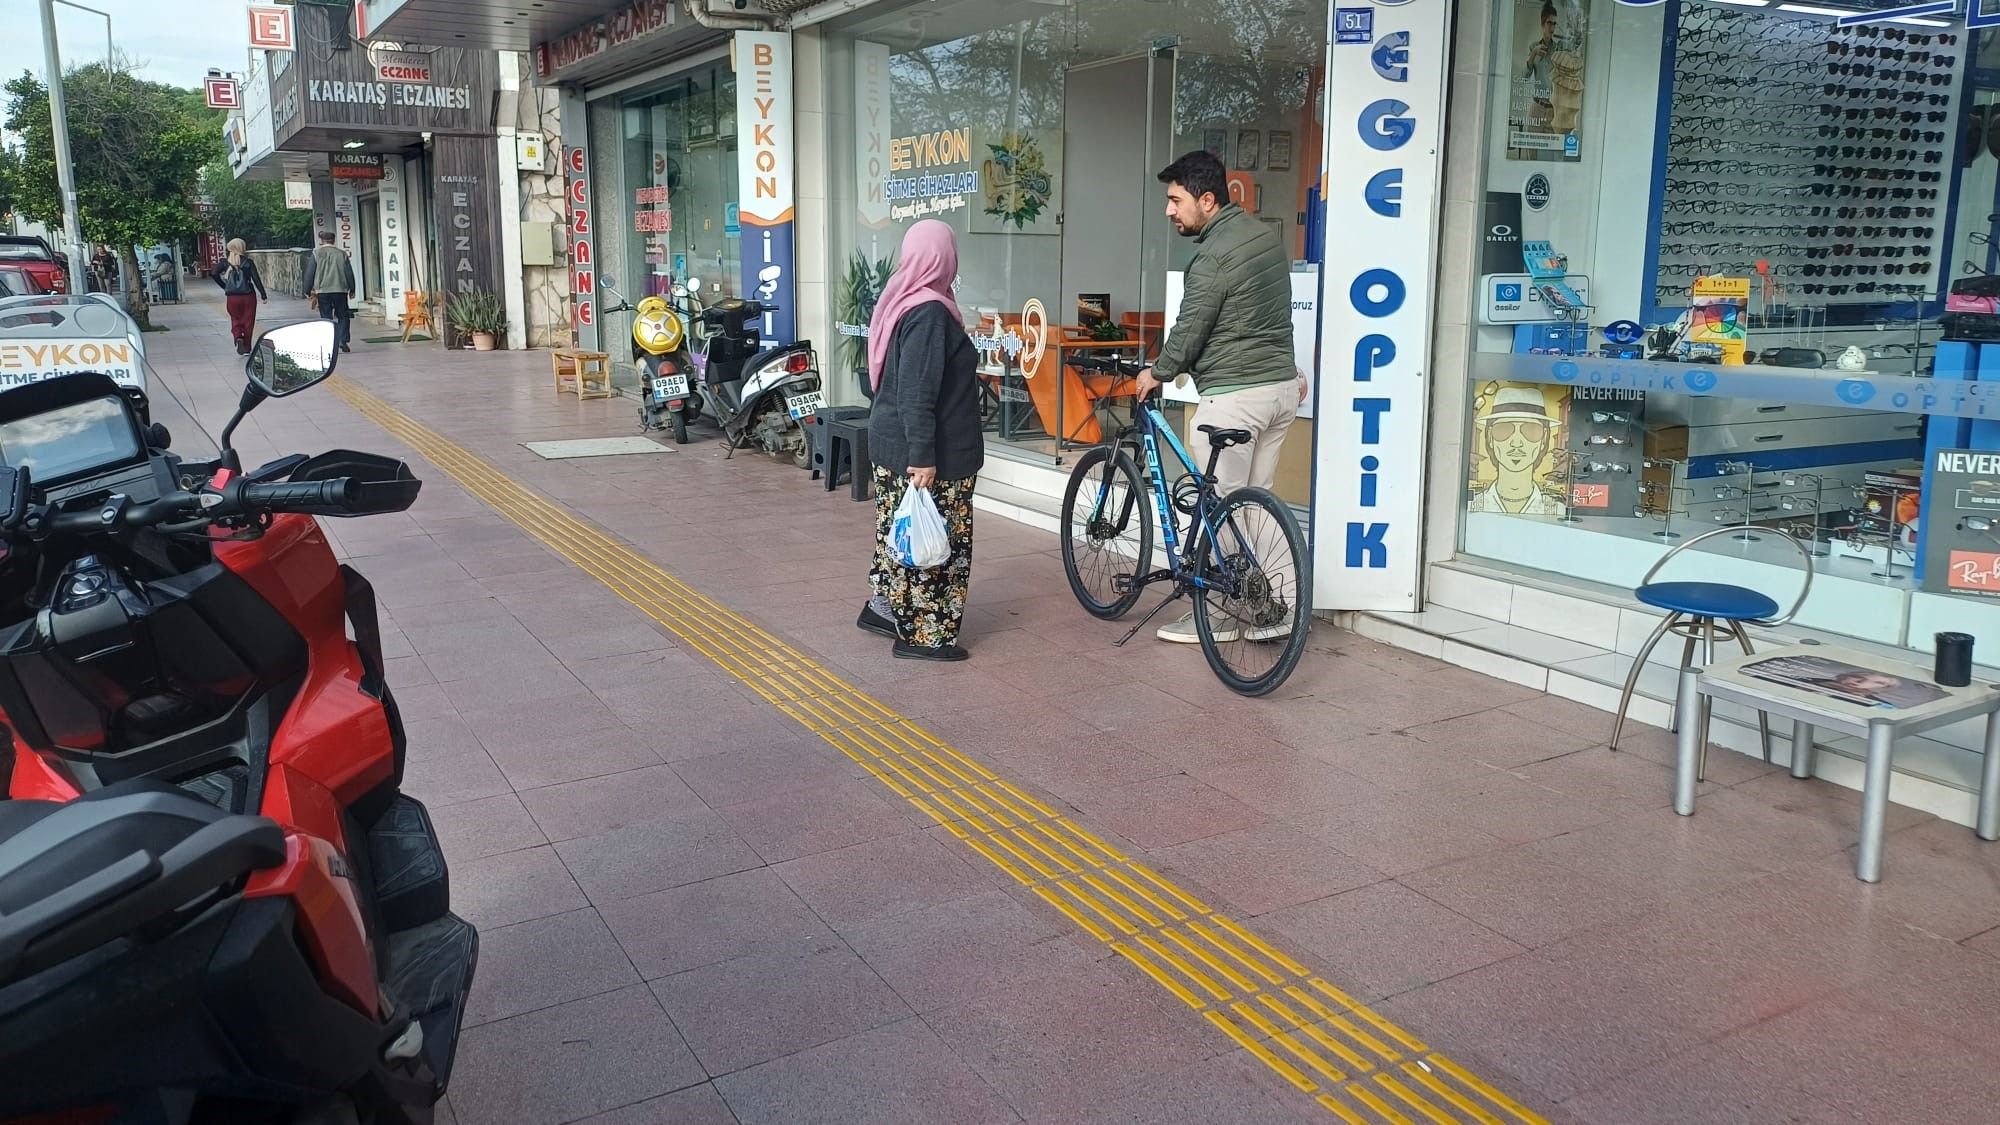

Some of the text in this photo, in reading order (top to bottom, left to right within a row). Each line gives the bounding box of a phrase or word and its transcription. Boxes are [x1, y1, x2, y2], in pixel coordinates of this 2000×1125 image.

[259, 15, 281, 39] E
[1345, 13, 1362, 29] 51
[380, 66, 429, 80] ECZANE
[212, 83, 233, 104] E
[309, 79, 470, 110] KARATAŞ ECZANESİ
[753, 43, 778, 199] BEYKON
[1357, 30, 1416, 218] EGE
[890, 127, 970, 171] BEYKON
[334, 154, 379, 166] KARATAŞ
[441, 175, 479, 185] KARATAŞ
[883, 170, 979, 206] İŞİTME CİHAZLARI
[571, 148, 593, 326] ECZANE
[386, 200, 400, 299] ECZANE
[1291, 301, 1313, 311] oruz
[0, 343, 129, 368] EYKON
[655, 377, 685, 388] 09AED
[663, 386, 681, 395] 630
[790, 394, 822, 408] 09AGN
[1573, 386, 1645, 401] NEVER HIDE
[1937, 453, 2000, 475] NEVER
